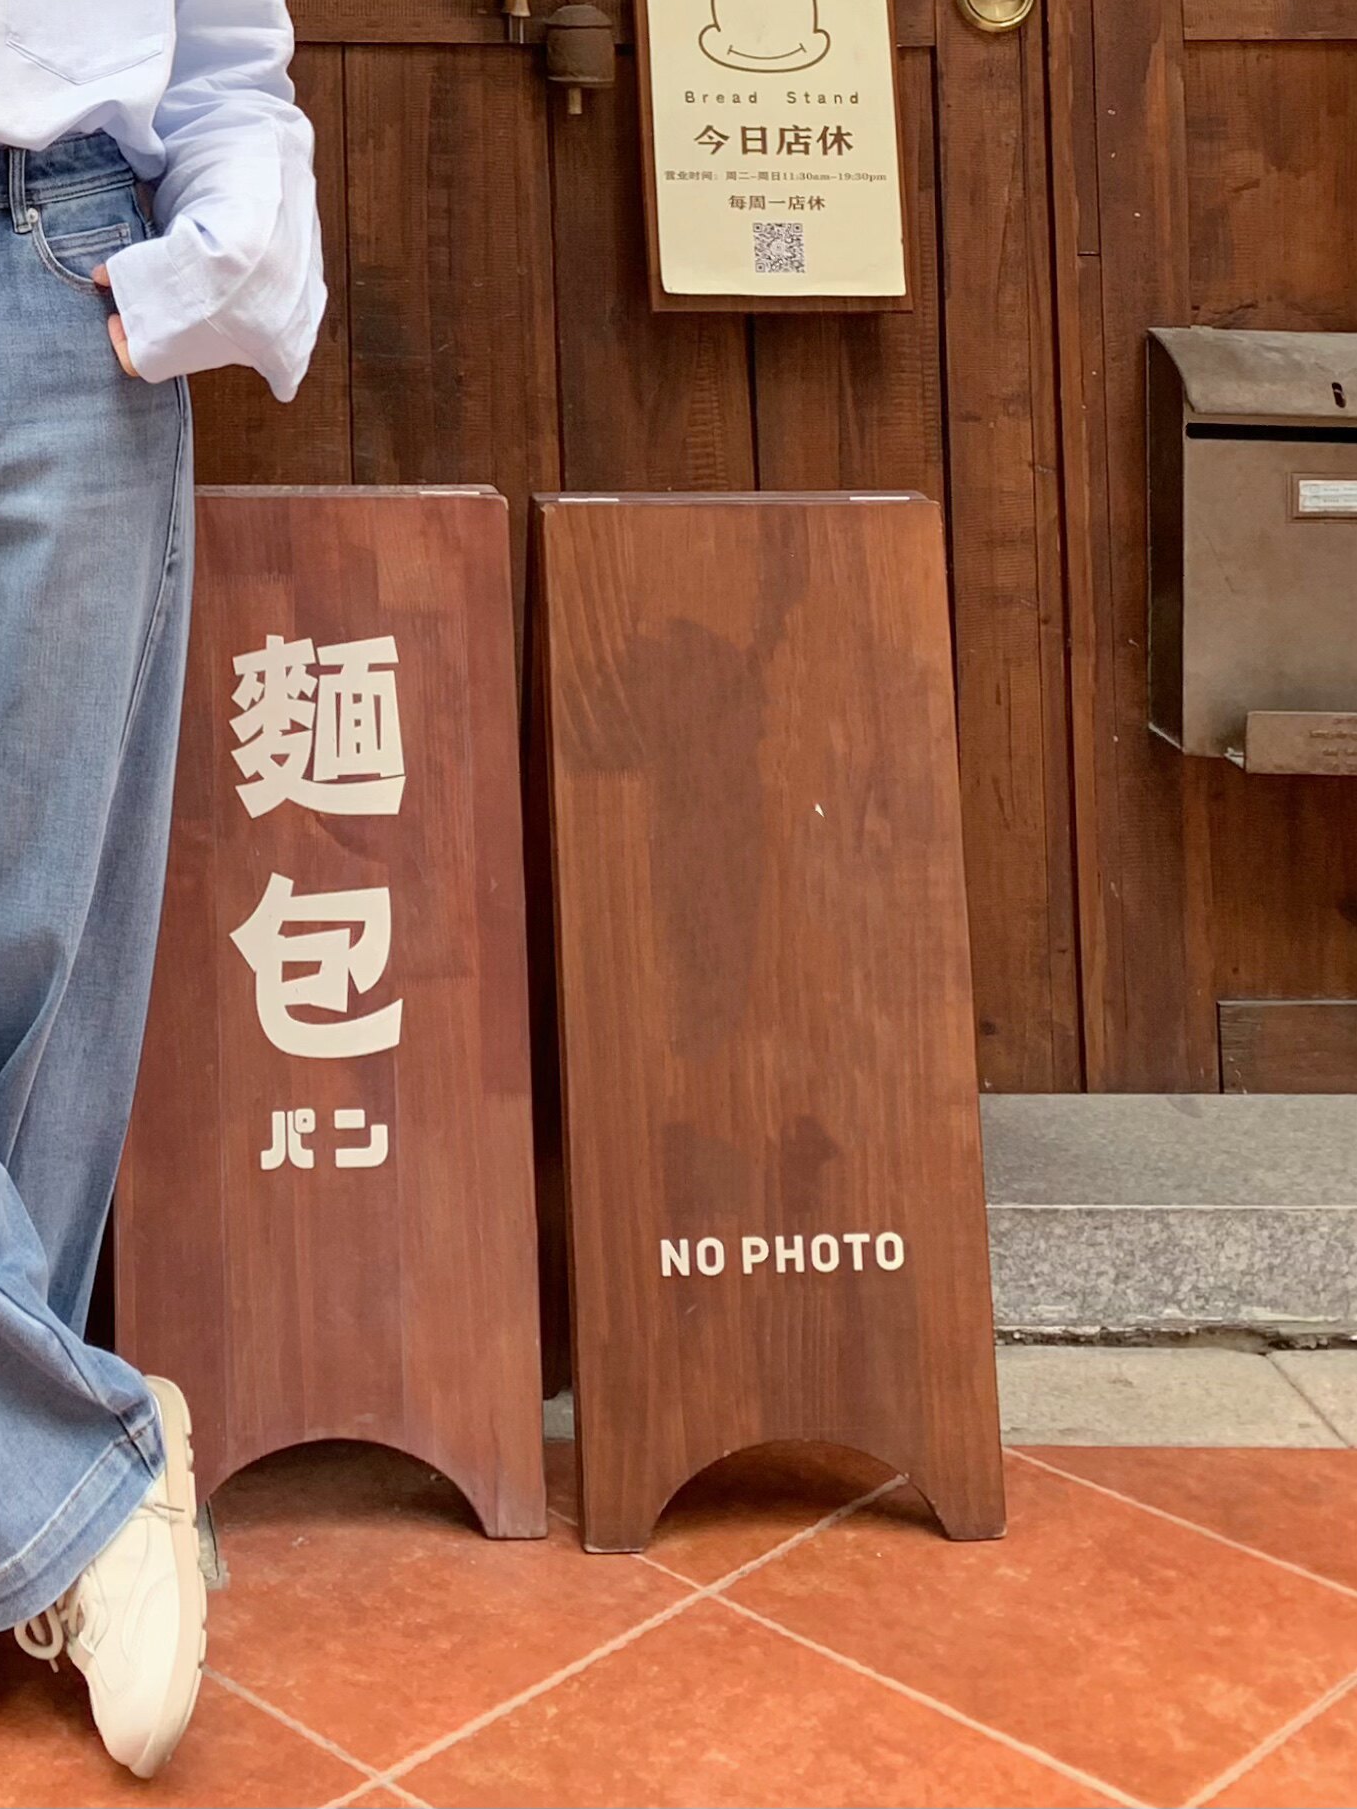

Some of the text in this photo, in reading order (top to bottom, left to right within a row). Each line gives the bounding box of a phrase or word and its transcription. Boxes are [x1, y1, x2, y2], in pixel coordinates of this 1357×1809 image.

[684, 90, 859, 105] Bread Stand
[694, 124, 854, 156] 今日店休
[728, 194, 826, 211] 每周一店休
[260, 1108, 389, 1170] パン
[660, 1231, 905, 1277] NO PHOTO
